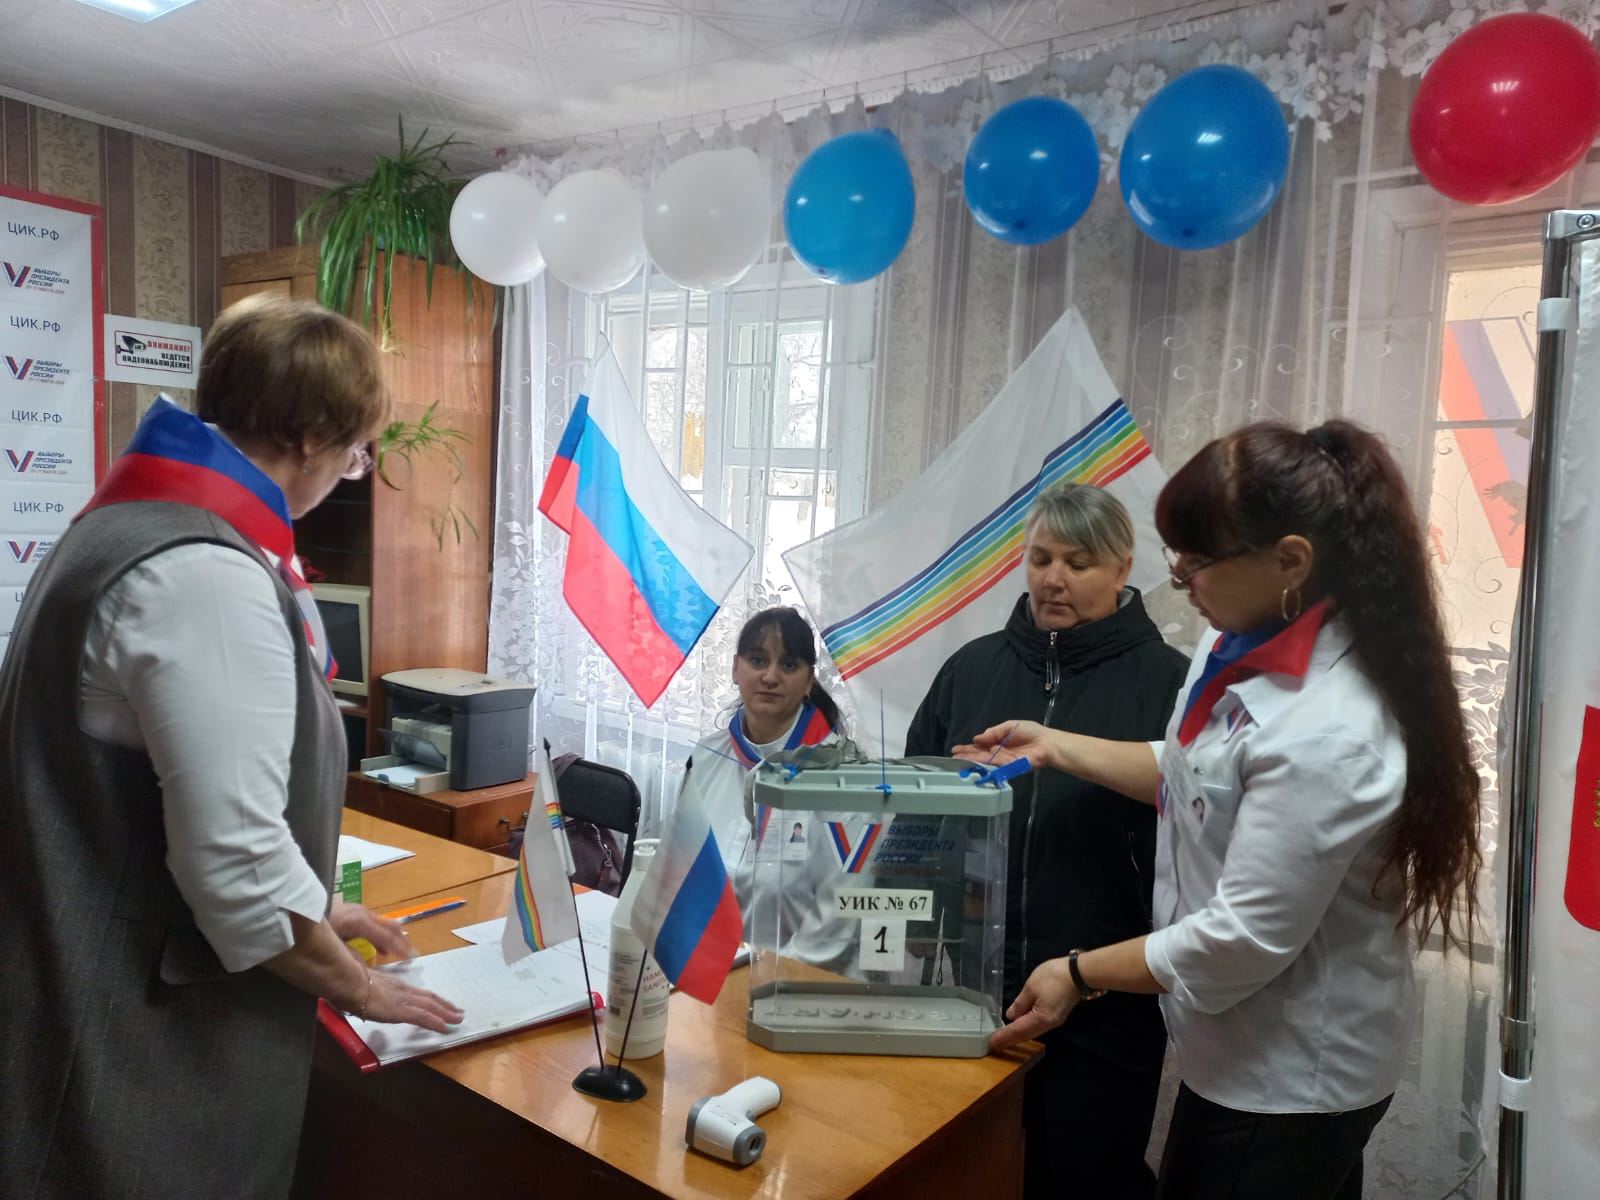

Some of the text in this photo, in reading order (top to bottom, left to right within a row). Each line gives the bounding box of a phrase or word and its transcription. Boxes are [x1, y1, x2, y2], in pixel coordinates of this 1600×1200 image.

[7, 221, 60, 240] ЦИК.РФ
[10, 315, 61, 332] ЦИК.РФ
[147, 340, 190, 352] ВНИМАНИЕ!
[122, 355, 190, 370] ВИДЕОНАБЛЮДЕНИЕ
[11, 409, 62, 423] ЦИК.РФ
[13, 501, 64, 513] ЦИК.РФ
[888, 824, 939, 837] ВЫБОРЫ
[881, 838, 955, 851] ПРЕЗИДЕНТА
[874, 852, 922, 865] РОССИИ
[838, 896, 928, 911] УИК № 67
